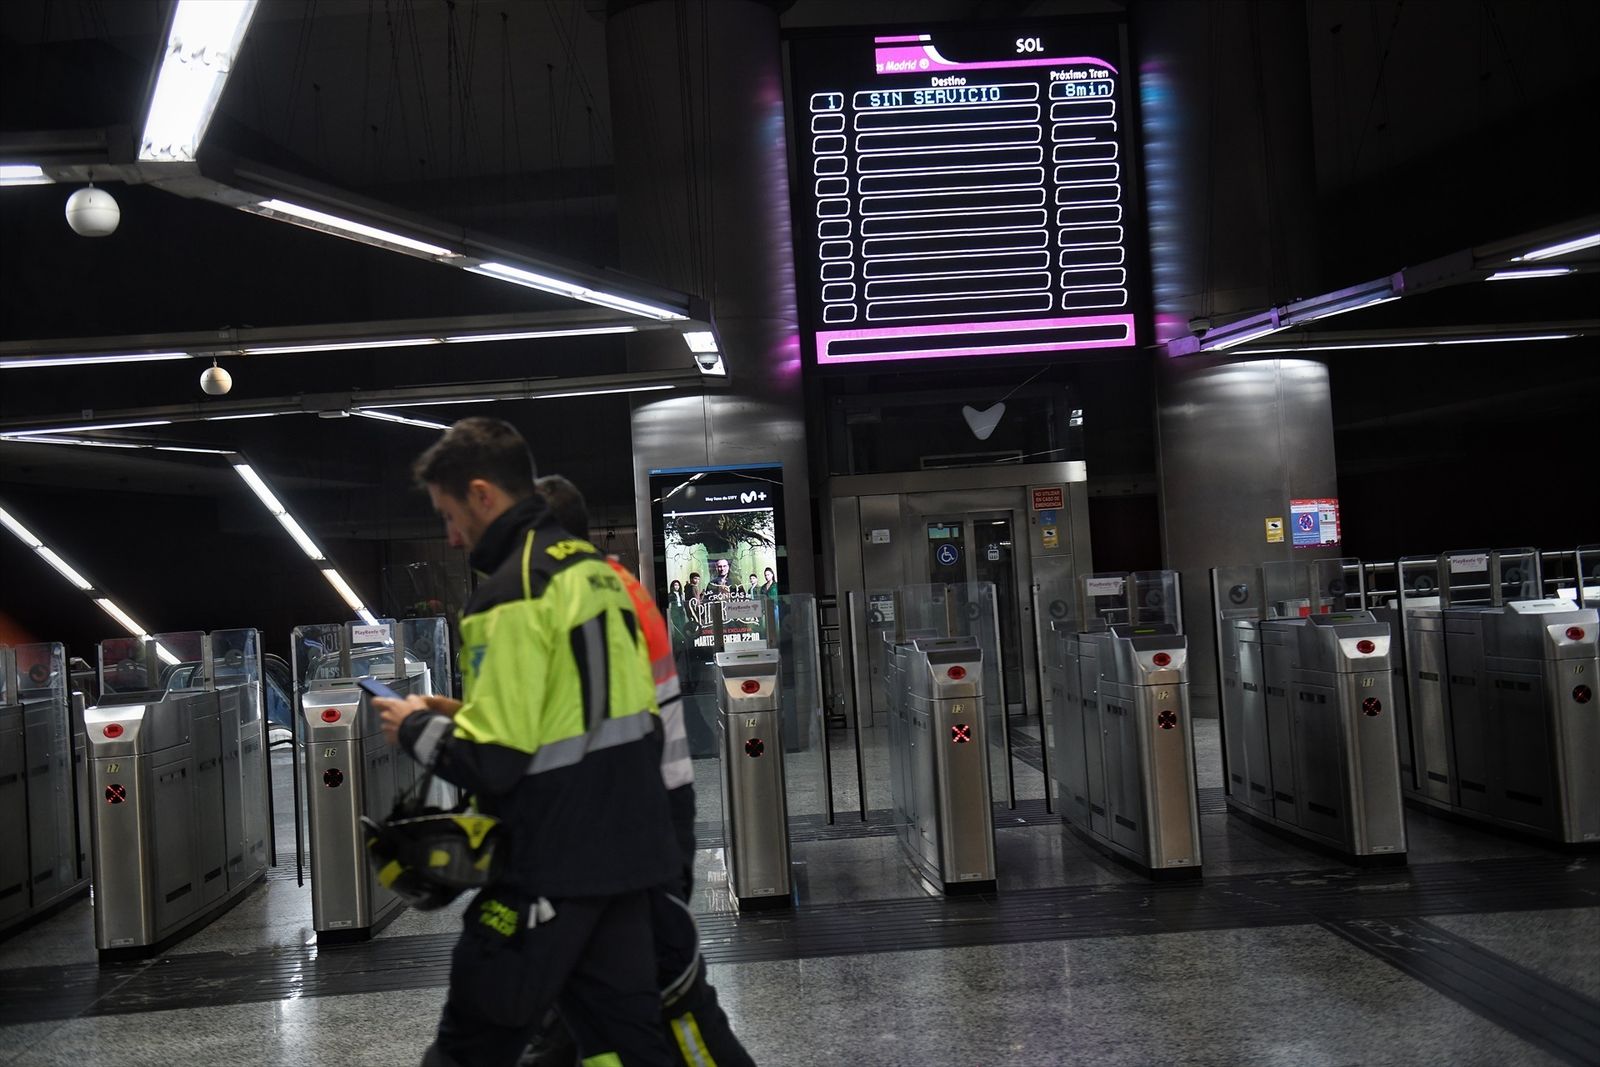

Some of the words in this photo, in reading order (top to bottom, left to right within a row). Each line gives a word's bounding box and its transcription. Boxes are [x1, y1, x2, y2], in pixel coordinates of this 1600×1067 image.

[1016, 38, 1044, 53] SOL
[885, 59, 917, 71] Madrid
[1050, 70, 1087, 81] Próximo
[1088, 69, 1109, 79] Tren
[931, 76, 966, 87] Destino
[1065, 83, 1108, 97] 8min
[827, 95, 836, 109] 1
[870, 91, 903, 107] SIN
[913, 87, 1001, 106] SERVICIO
[745, 718, 757, 728] 14
[324, 748, 336, 758] 16
